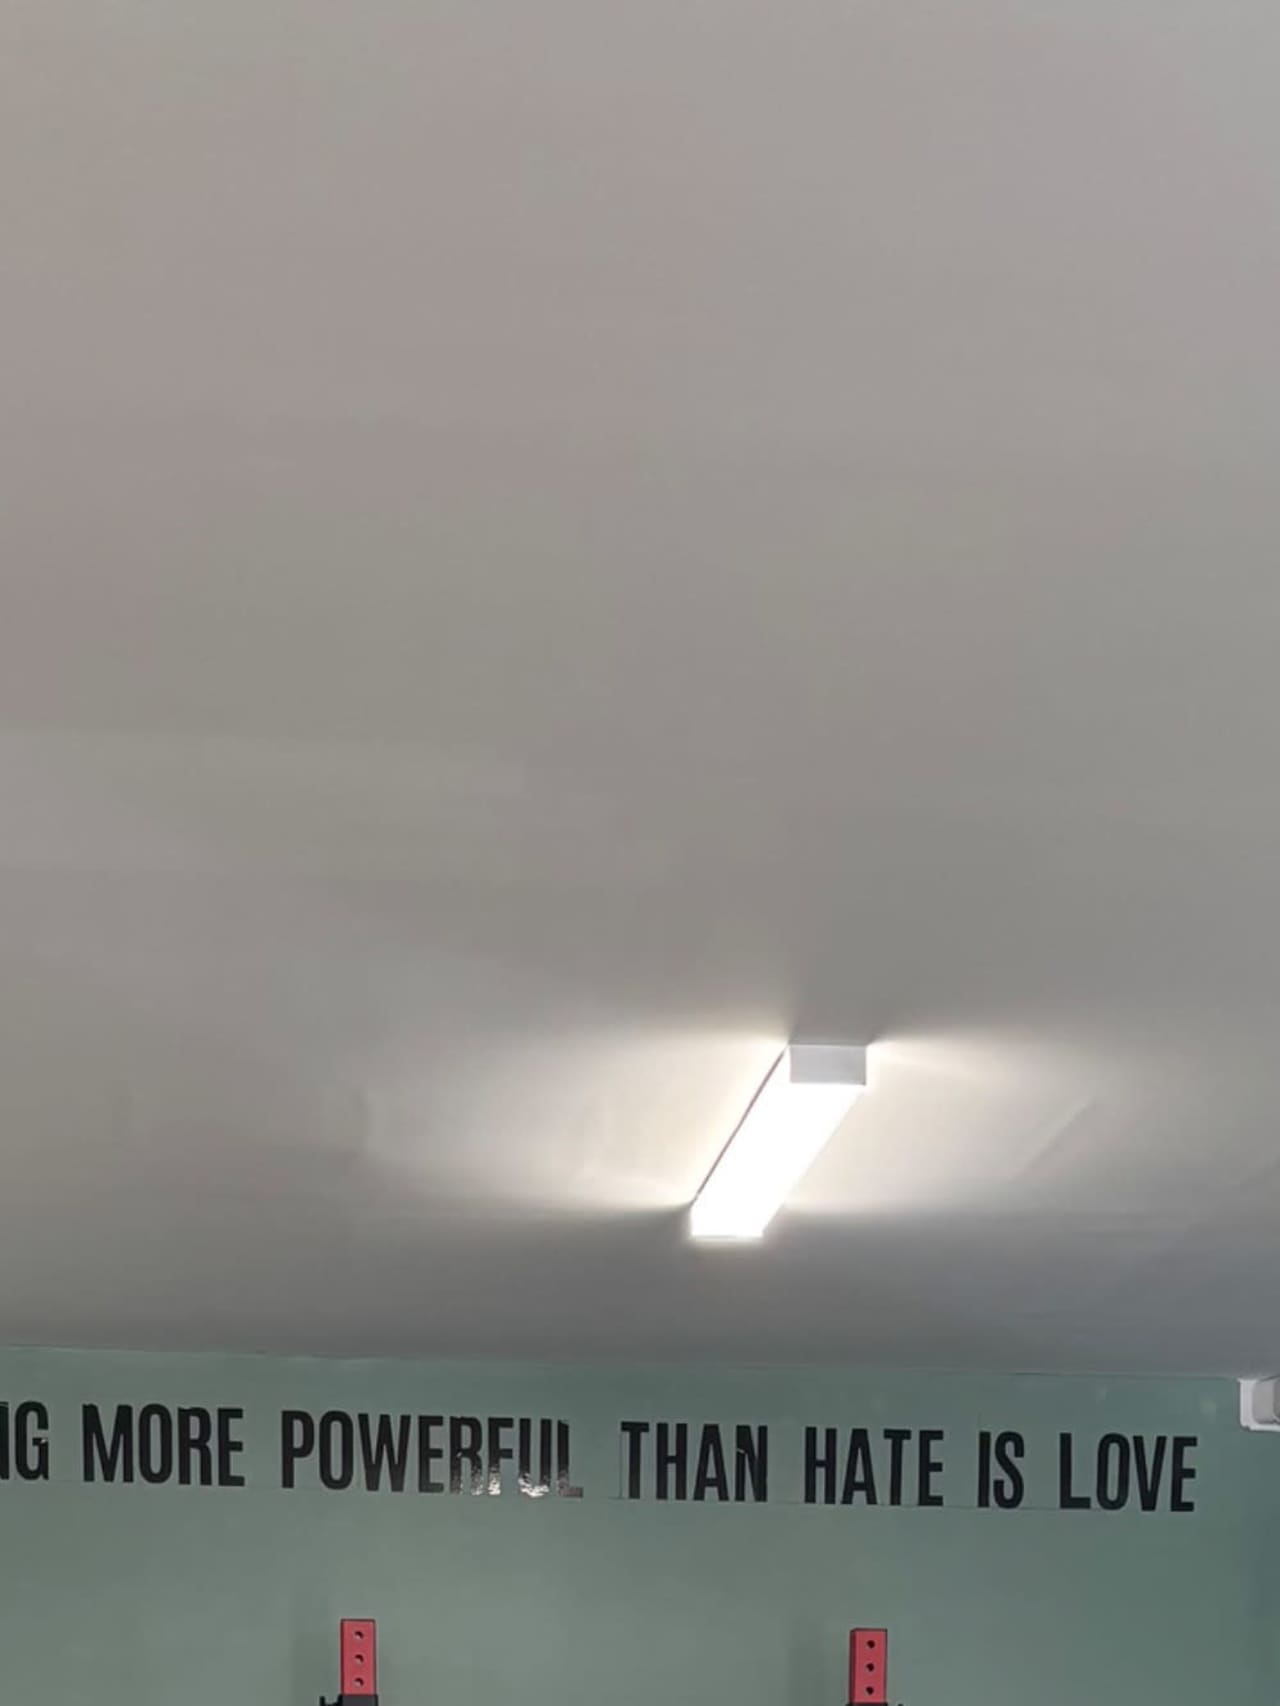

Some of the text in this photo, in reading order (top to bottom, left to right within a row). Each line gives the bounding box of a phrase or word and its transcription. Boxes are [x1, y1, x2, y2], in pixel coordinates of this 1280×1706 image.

[82, 1403, 245, 1488] MORE
[282, 1409, 584, 1498] POWERFUL
[621, 1421, 768, 1503] THAN
[804, 1427, 945, 1508] HATE
[977, 1431, 1025, 1510] IS
[1058, 1432, 1198, 1513] LOVE
